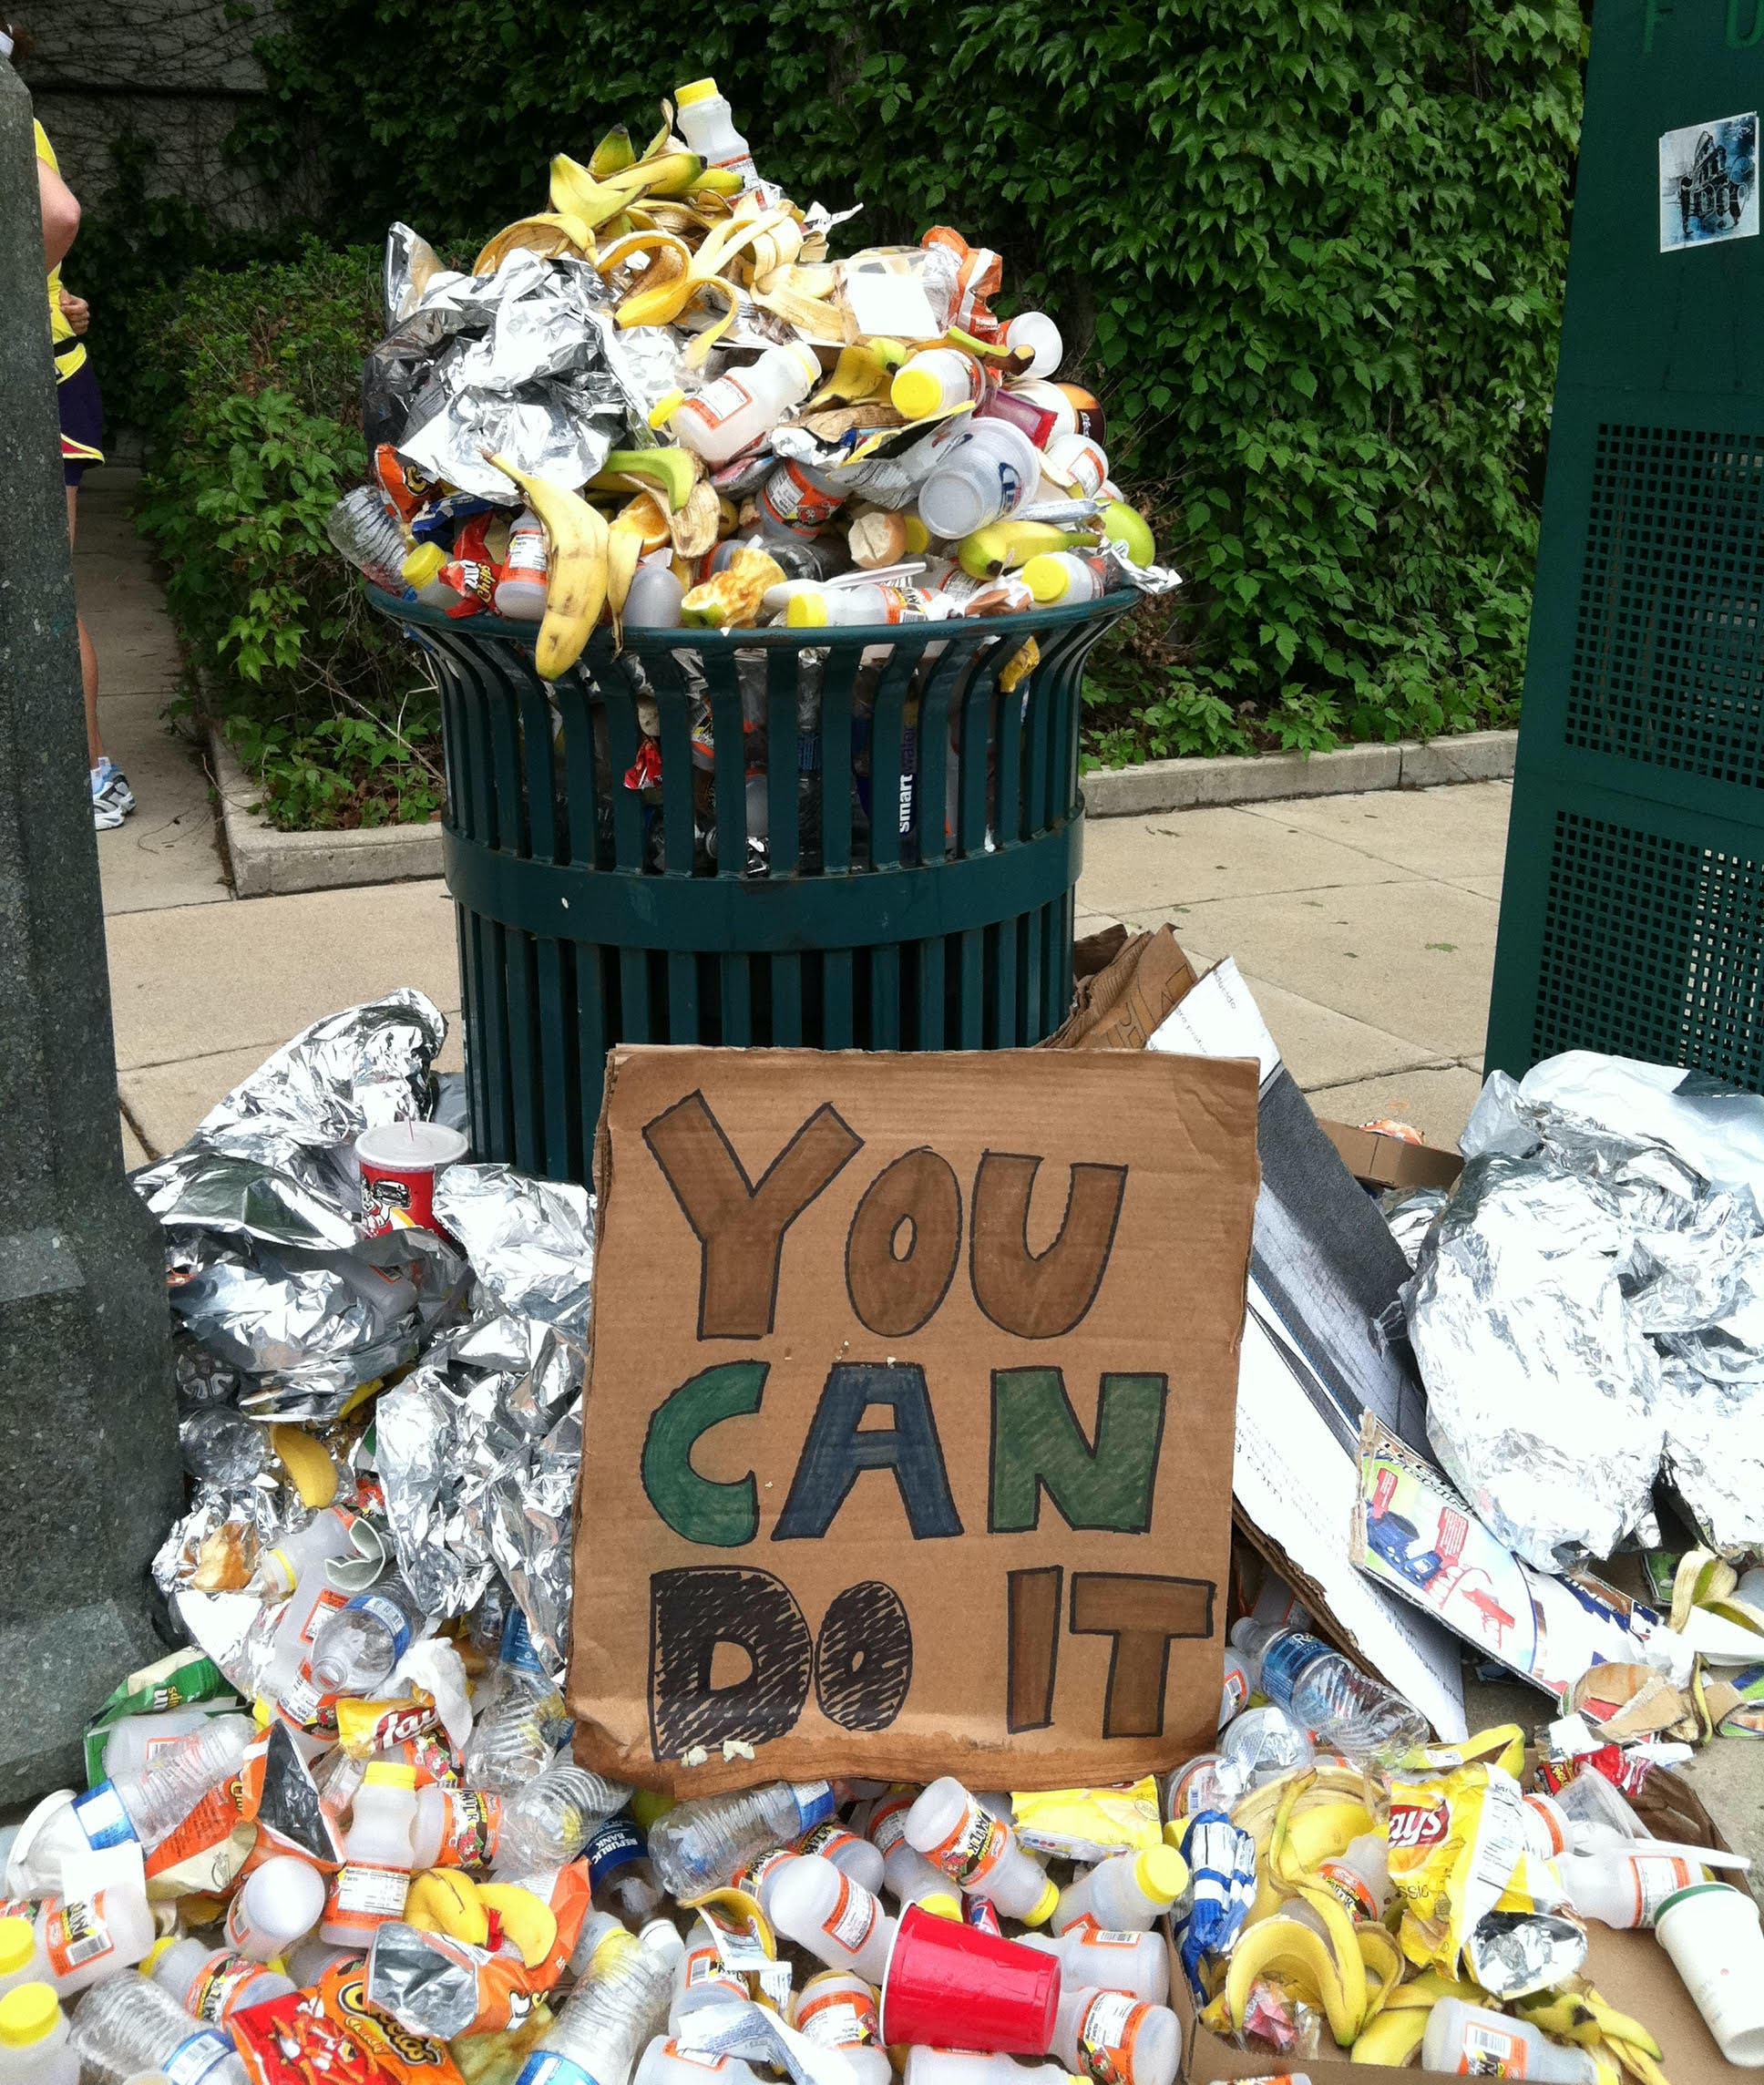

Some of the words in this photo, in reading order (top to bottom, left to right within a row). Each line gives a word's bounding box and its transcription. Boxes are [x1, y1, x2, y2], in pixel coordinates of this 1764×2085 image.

[899, 774, 913, 833] smart
[641, 1089, 1129, 1340] YOU
[641, 1359, 1168, 1547] CAN
[647, 1565, 913, 1762] DO
[1008, 1565, 1217, 1739] IT
[591, 1838, 638, 1864] REPUBLIC
[595, 1833, 625, 1850] BANK
